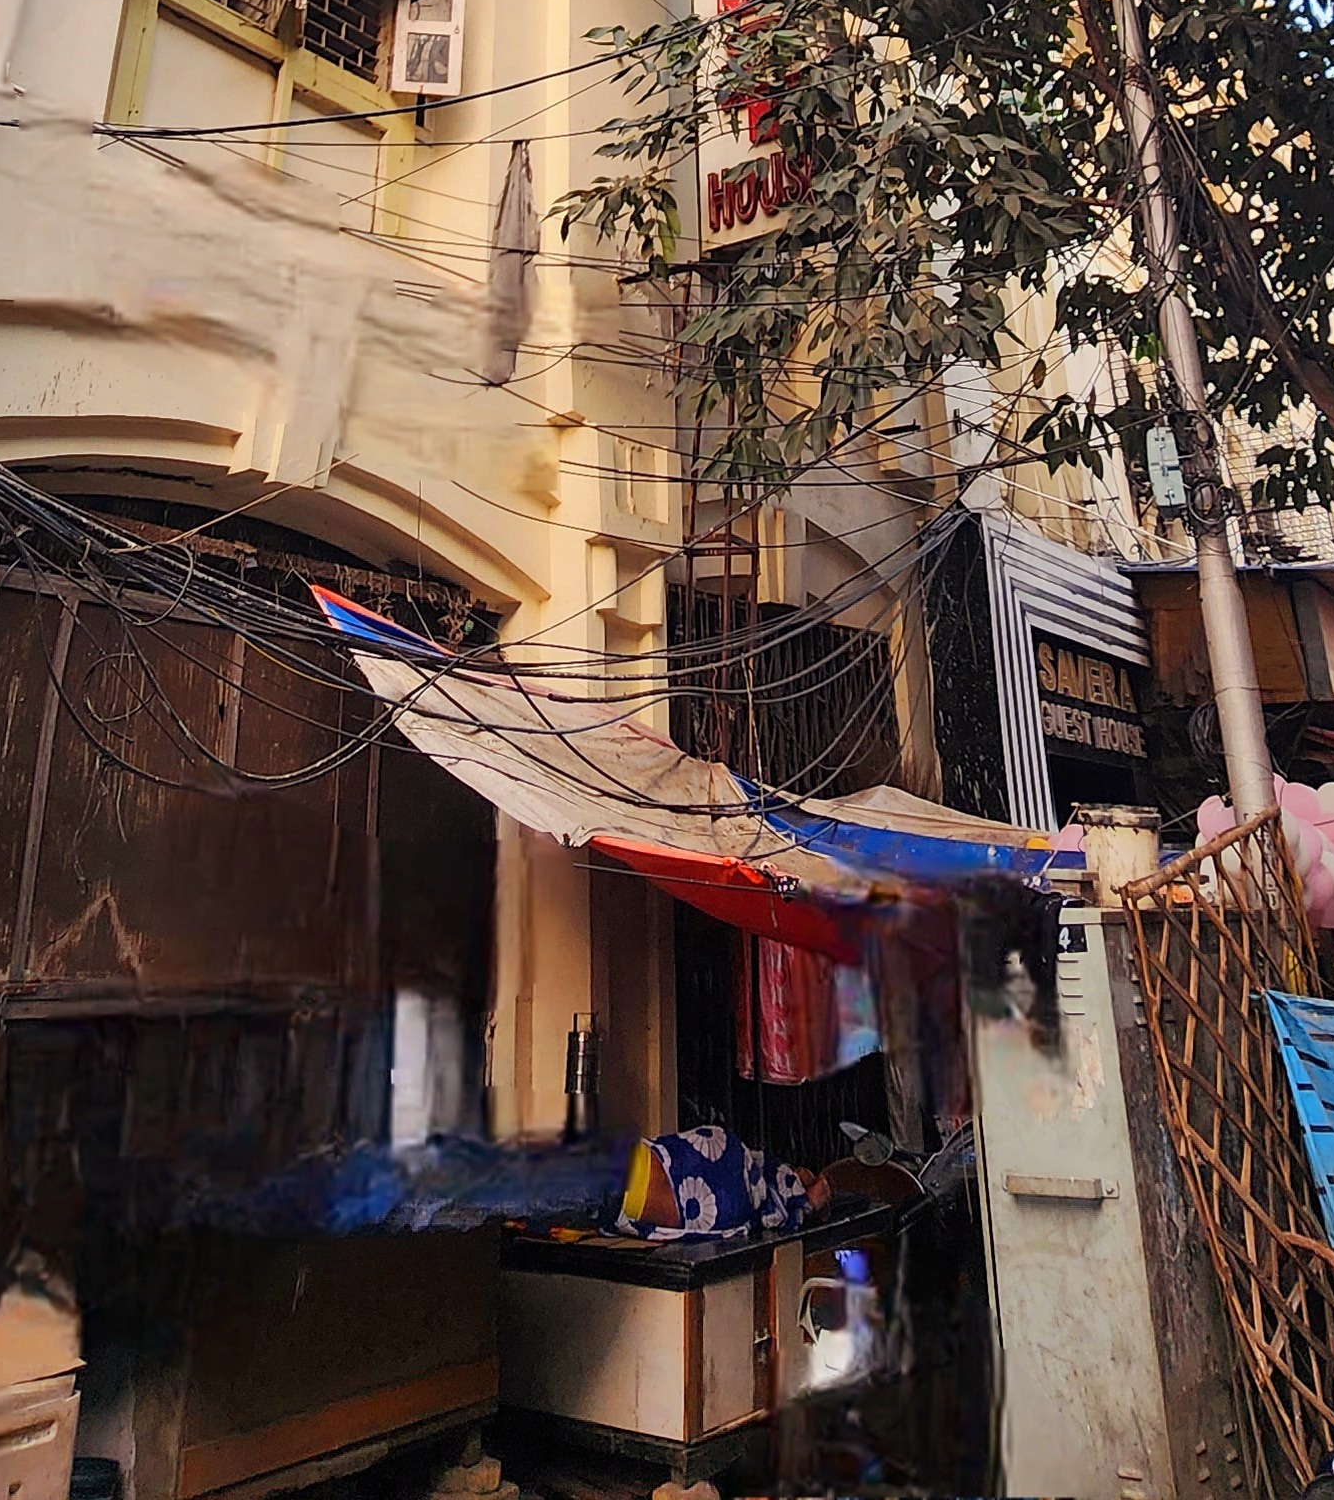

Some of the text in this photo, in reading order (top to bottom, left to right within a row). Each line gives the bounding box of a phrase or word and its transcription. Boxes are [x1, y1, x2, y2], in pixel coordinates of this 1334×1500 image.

[1037, 642, 1137, 714] SAVERA
[1040, 700, 1148, 759] GUEST HOUSE
